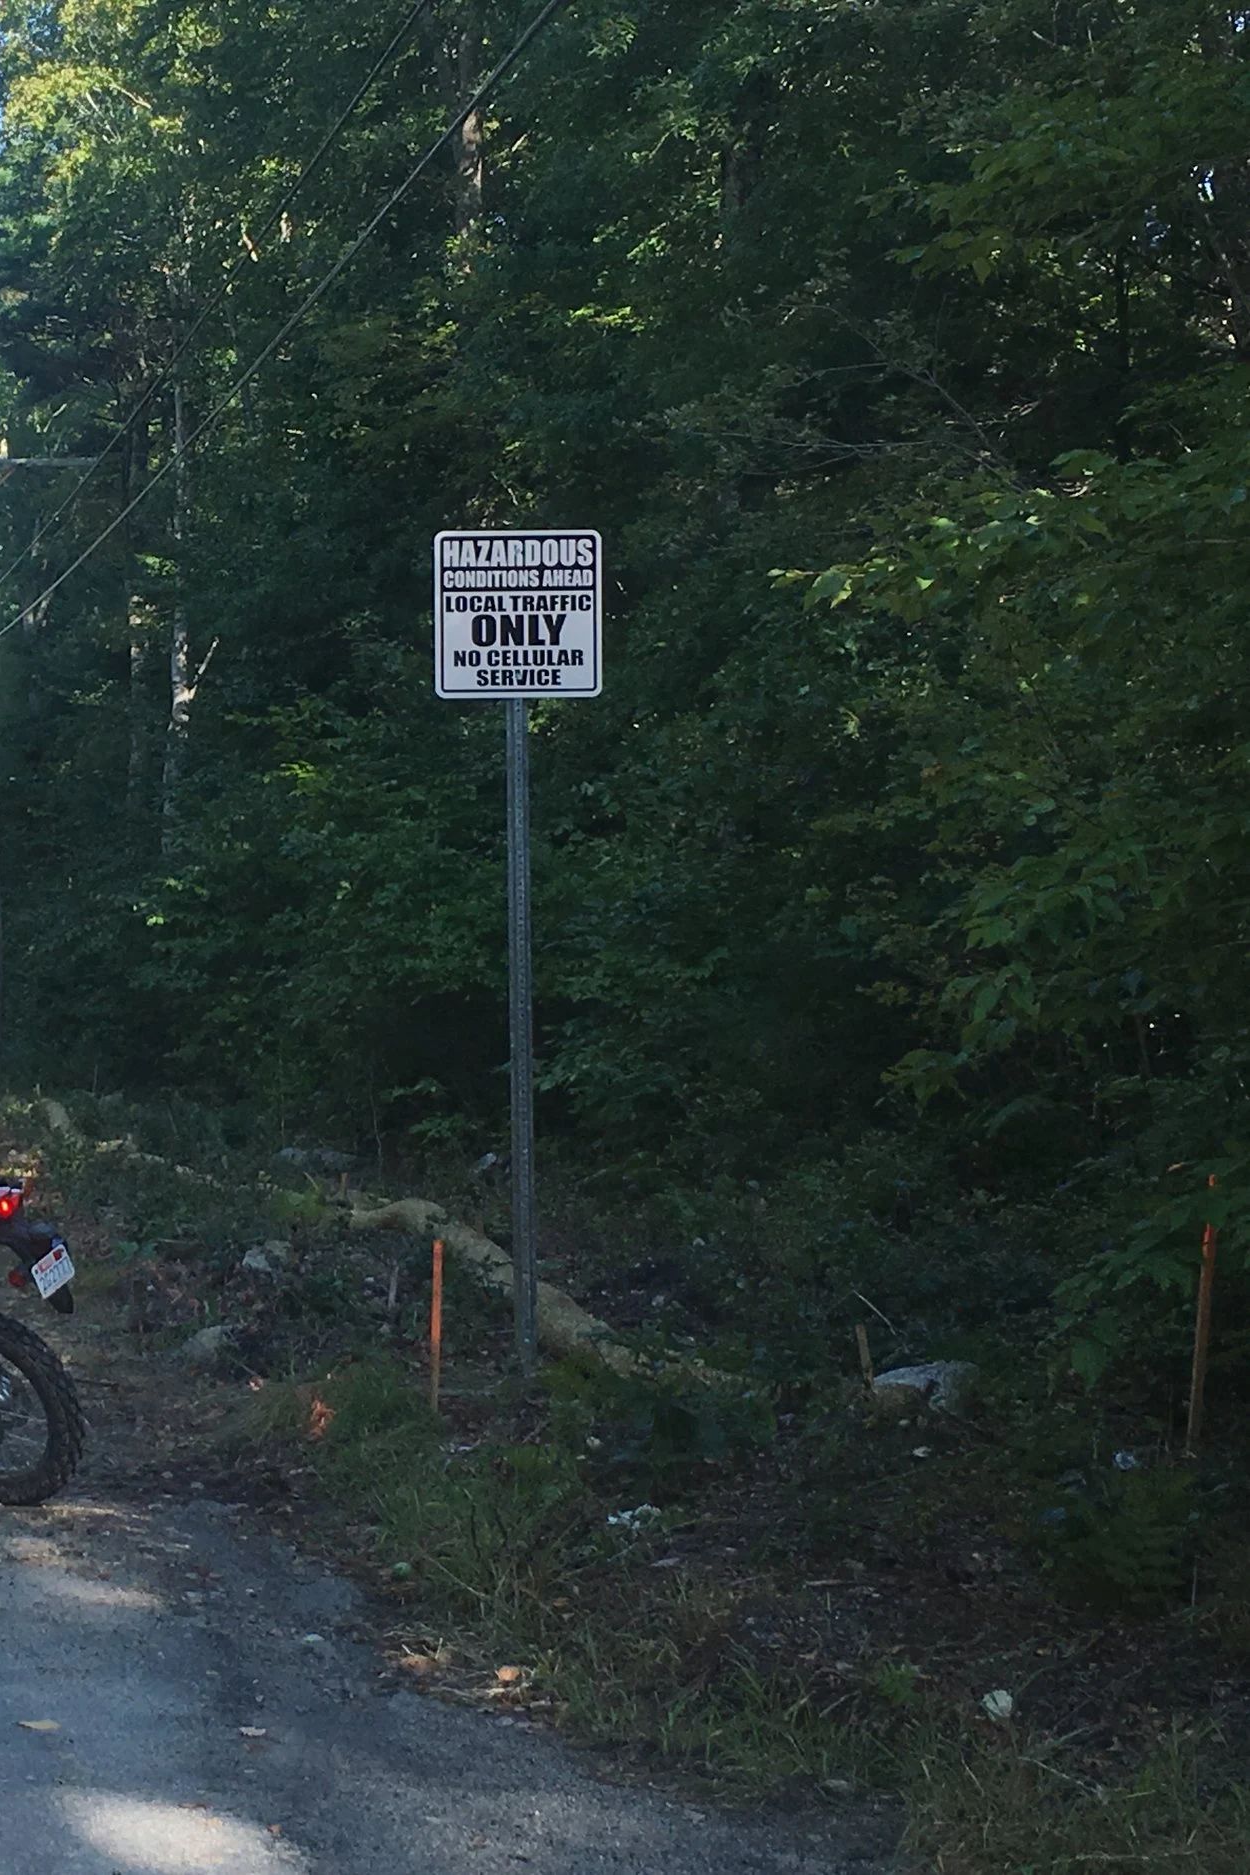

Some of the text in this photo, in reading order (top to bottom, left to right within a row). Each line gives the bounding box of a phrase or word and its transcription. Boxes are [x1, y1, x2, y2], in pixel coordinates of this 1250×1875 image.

[443, 538, 594, 568] HAZARDOUS
[443, 568, 594, 589] CONDITIONS AHEAD
[445, 594, 592, 613] LOCAL TRAFFIC
[471, 613, 567, 647] ONLY
[454, 649, 584, 667] NO CELLULAR
[476, 669, 562, 687] SERVICE
